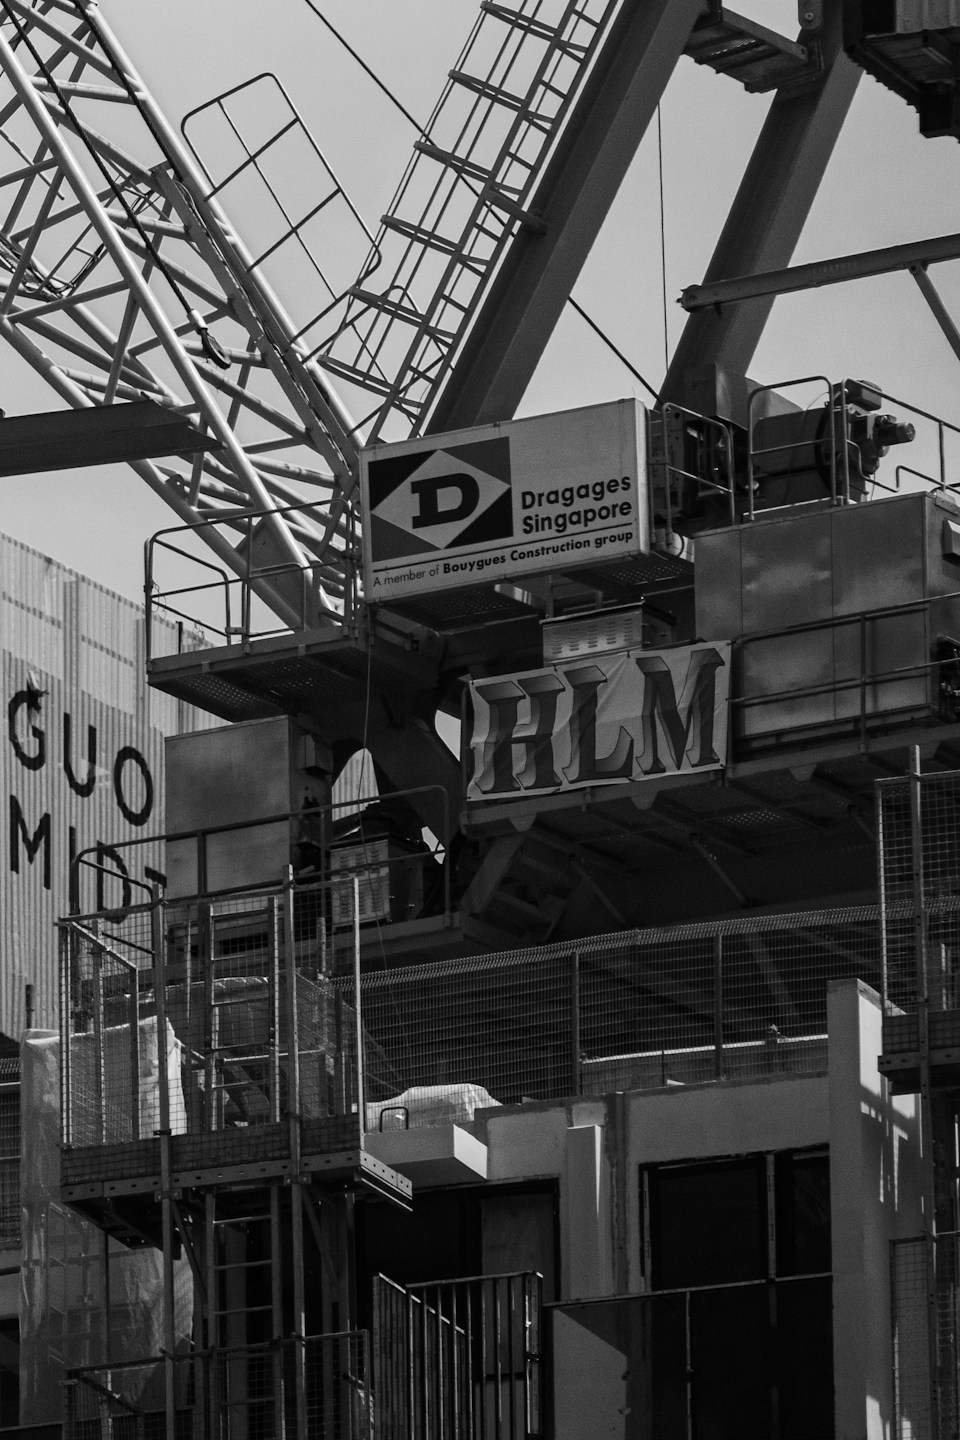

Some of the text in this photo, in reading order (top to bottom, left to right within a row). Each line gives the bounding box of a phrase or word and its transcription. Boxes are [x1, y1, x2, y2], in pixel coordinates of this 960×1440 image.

[411, 472, 480, 529] D
[521, 475, 631, 510] Dragages
[522, 500, 632, 535] Singapore
[373, 531, 633, 588] A member of Bouygues Construction group
[475, 648, 725, 794] HLM
